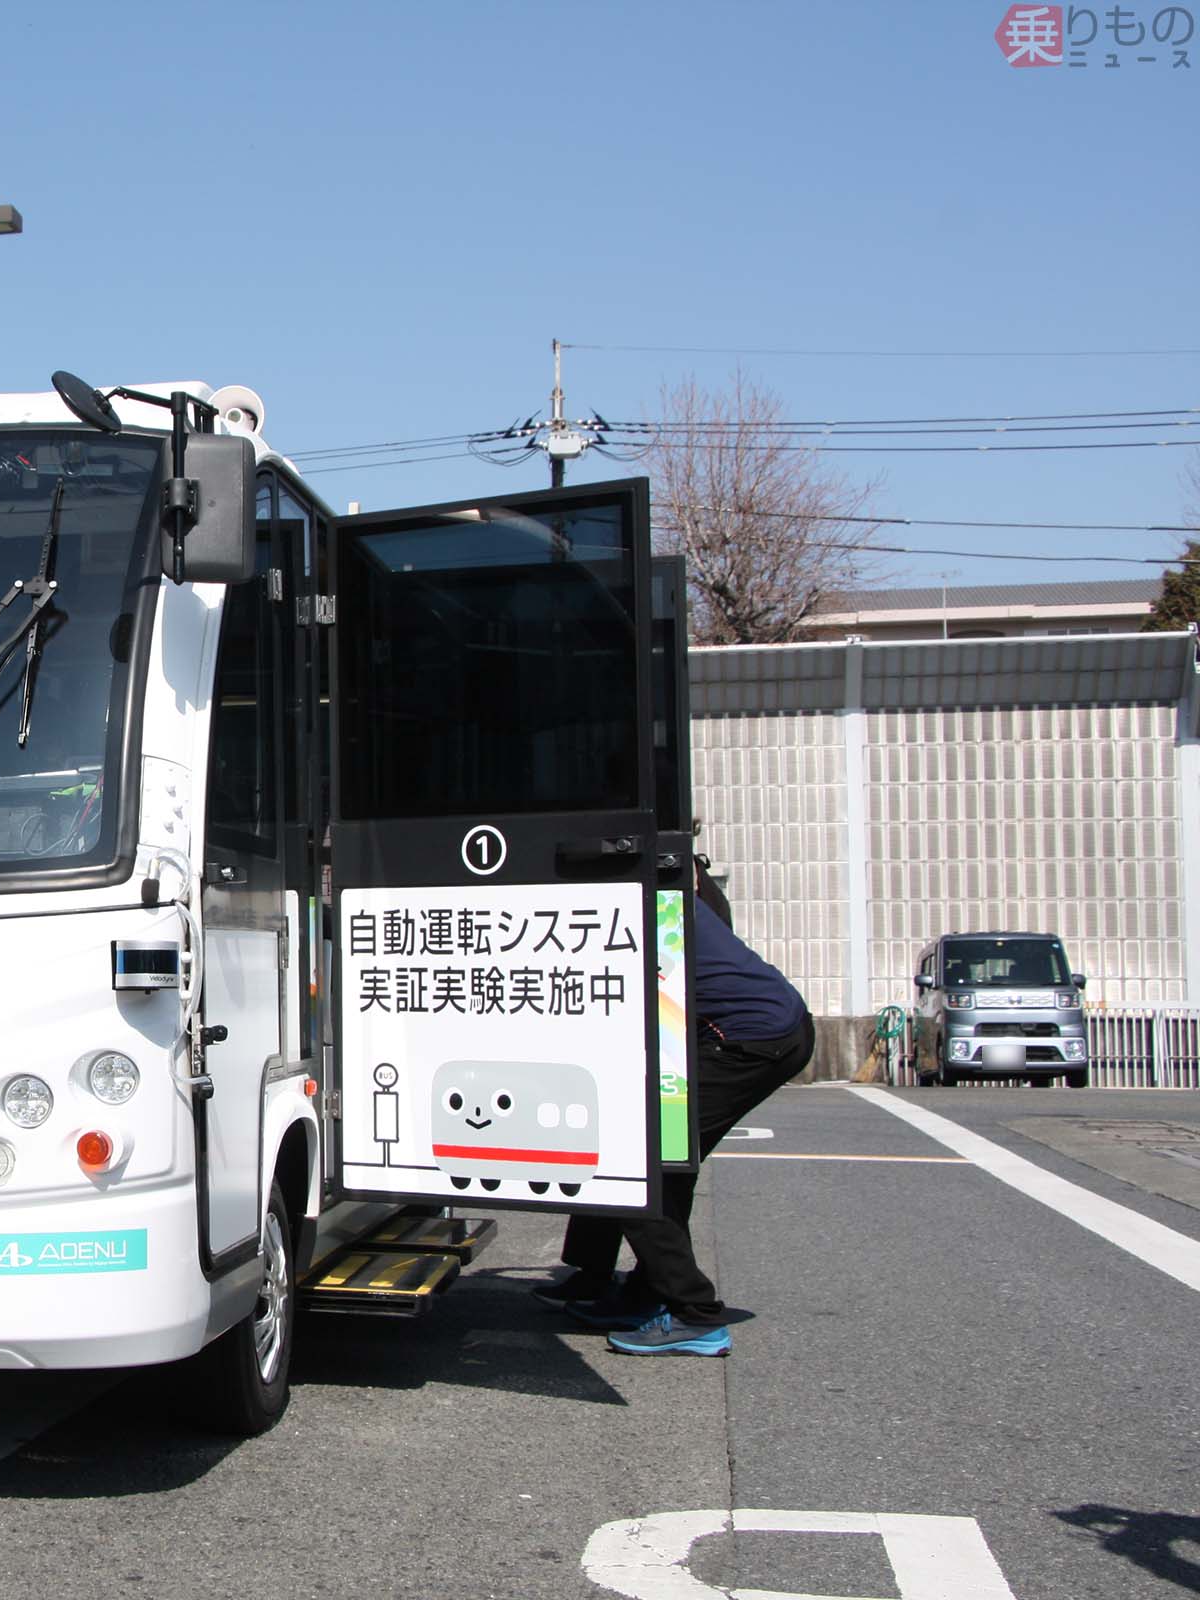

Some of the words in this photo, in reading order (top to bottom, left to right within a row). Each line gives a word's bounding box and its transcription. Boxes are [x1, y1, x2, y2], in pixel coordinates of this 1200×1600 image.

[349, 907, 639, 957] 自動運転システム
[358, 965, 626, 1017] 実証実験実施中
[379, 1071, 393, 1080] BUS
[38, 1240, 128, 1261] ADENU
